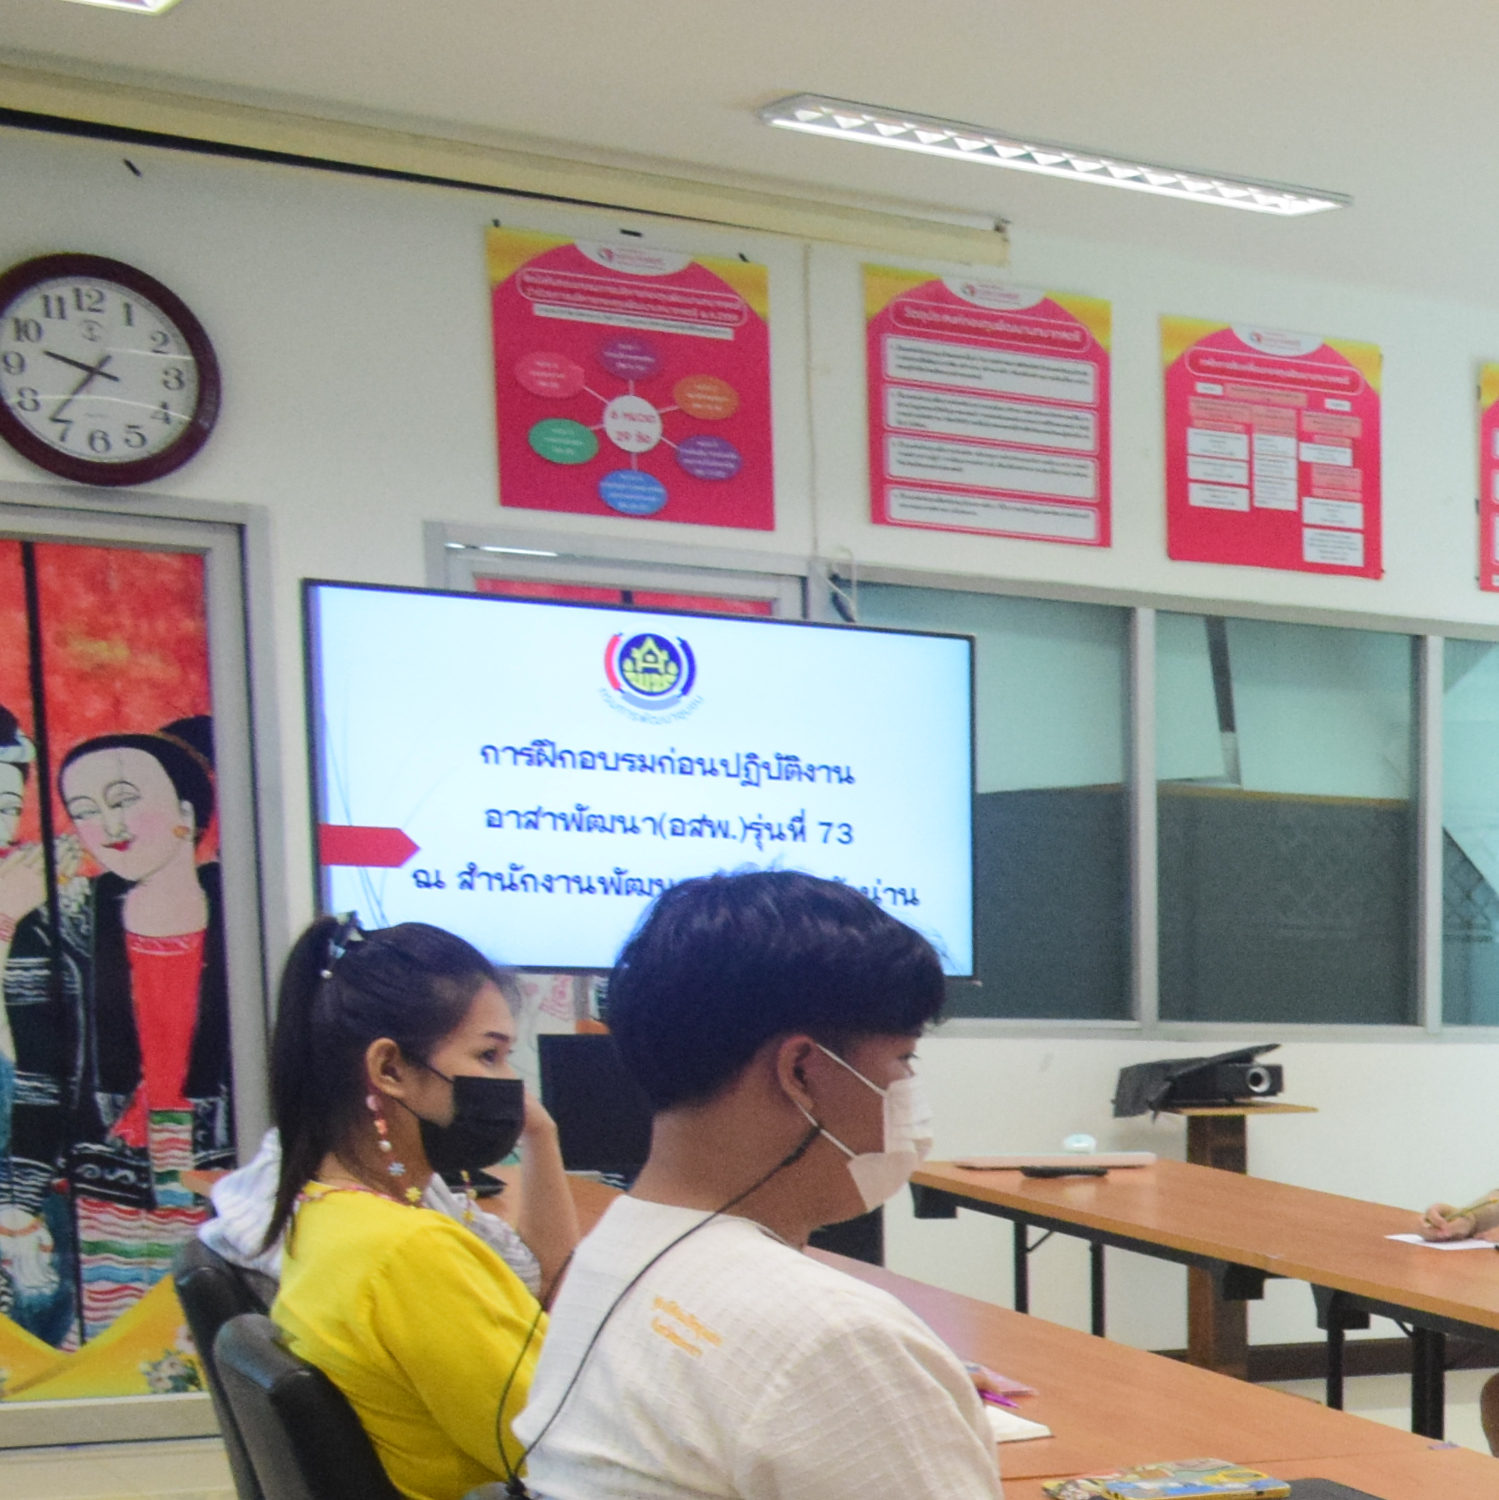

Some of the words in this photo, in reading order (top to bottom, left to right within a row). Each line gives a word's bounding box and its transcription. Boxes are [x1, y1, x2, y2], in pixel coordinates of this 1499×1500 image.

[42, 294, 67, 320] 11
[74, 286, 104, 314] 12
[123, 302, 135, 327] 1
[13, 317, 43, 343] 10
[150, 330, 170, 354] 2
[3, 351, 25, 375] 9
[162, 366, 185, 391] 3
[17, 386, 40, 412] 8
[150, 401, 171, 425] 4
[51, 417, 74, 442] 7
[88, 429, 112, 453] 6
[124, 424, 147, 449] 5
[480, 740, 855, 786] การฝึกอบรมก่อนปฏิบัติงาน
[818, 820, 855, 845] 73
[413, 871, 445, 890] ณ
